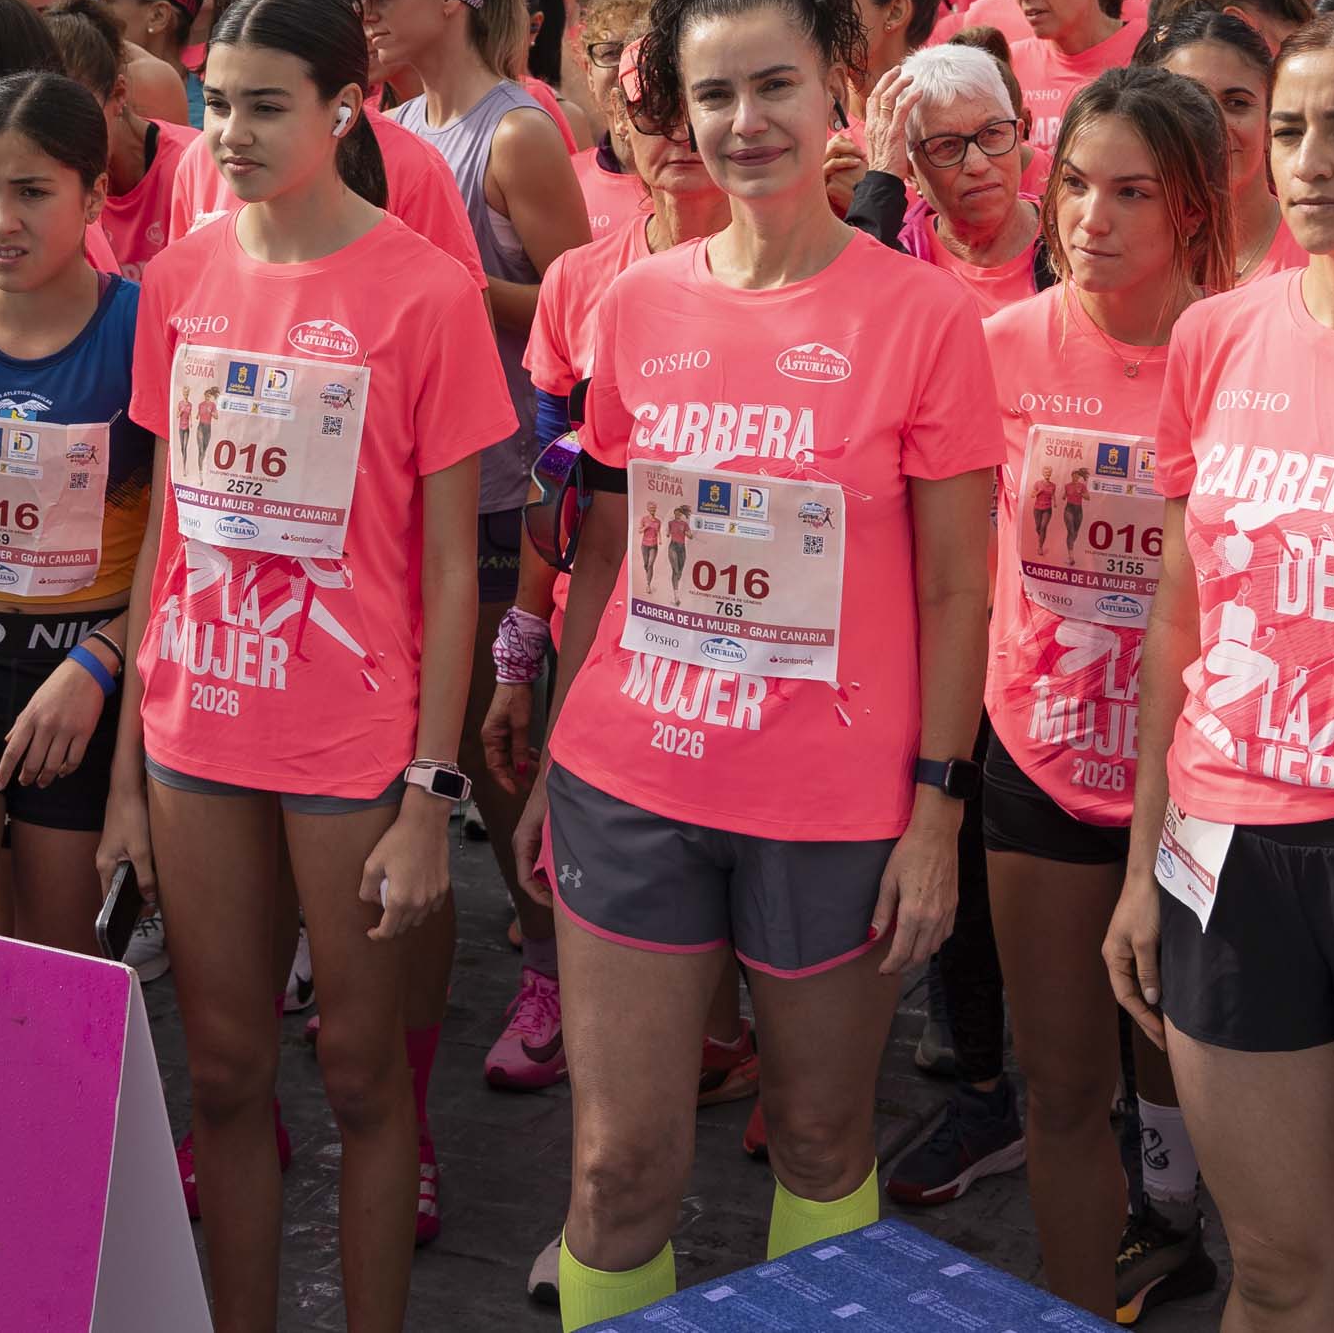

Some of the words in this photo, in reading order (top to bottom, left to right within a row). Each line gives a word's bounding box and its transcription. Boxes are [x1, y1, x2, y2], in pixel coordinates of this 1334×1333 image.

[289, 328, 354, 354] ASTURIANA
[185, 364, 215, 379] SUMA
[641, 349, 711, 378] OYSHO
[781, 353, 846, 377] ASTURIANA
[1019, 392, 1103, 417] OYSHO
[1216, 388, 1290, 413] OYSHO
[634, 402, 814, 462] CARRERA
[213, 440, 287, 478] 016
[1045, 445, 1084, 460] SUMA
[227, 479, 263, 496] 2572
[647, 479, 684, 497] SUMA
[175, 488, 199, 503] CARRERA
[200, 494, 209, 504] DE
[210, 495, 219, 507] LA
[222, 497, 254, 512] MUJER
[263, 504, 291, 517] GRAN
[294, 508, 337, 523] CANARIA
[290, 534, 324, 544] Santander
[1088, 520, 1163, 557] 016
[21, 554, 46, 565] GRAN
[49, 553, 91, 565] CANARIA
[1106, 559, 1144, 575] 3155
[691, 560, 770, 600] 016
[1026, 565, 1068, 582] CARRERA
[1071, 574, 1084, 584] DE
[1086, 575, 1099, 587] LA
[1102, 577, 1137, 591] MUJER
[222, 562, 261, 630] LA
[715, 601, 743, 618] 765
[1039, 591, 1073, 607] OYSHO
[1099, 601, 1140, 614] ASTURIANA
[28, 618, 111, 650] NIK
[636, 603, 674, 622] CARRERA
[677, 614, 689, 625] DE
[691, 618, 703, 629] LA
[707, 620, 740, 635] MUJER
[750, 626, 777, 639] GRAN
[780, 630, 827, 643] CANARIA
[159, 620, 289, 691] MUJER
[645, 632, 679, 648] OYSHO
[704, 645, 743, 660] ASTURIANA
[779, 656, 814, 666] Santander
[190, 683, 240, 717] 2026
[621, 656, 766, 730] MUJER
[1255, 666, 1312, 749] LA
[1027, 687, 1138, 759] MUJE
[651, 721, 705, 760] 2026
[1071, 756, 1126, 792] 2026
